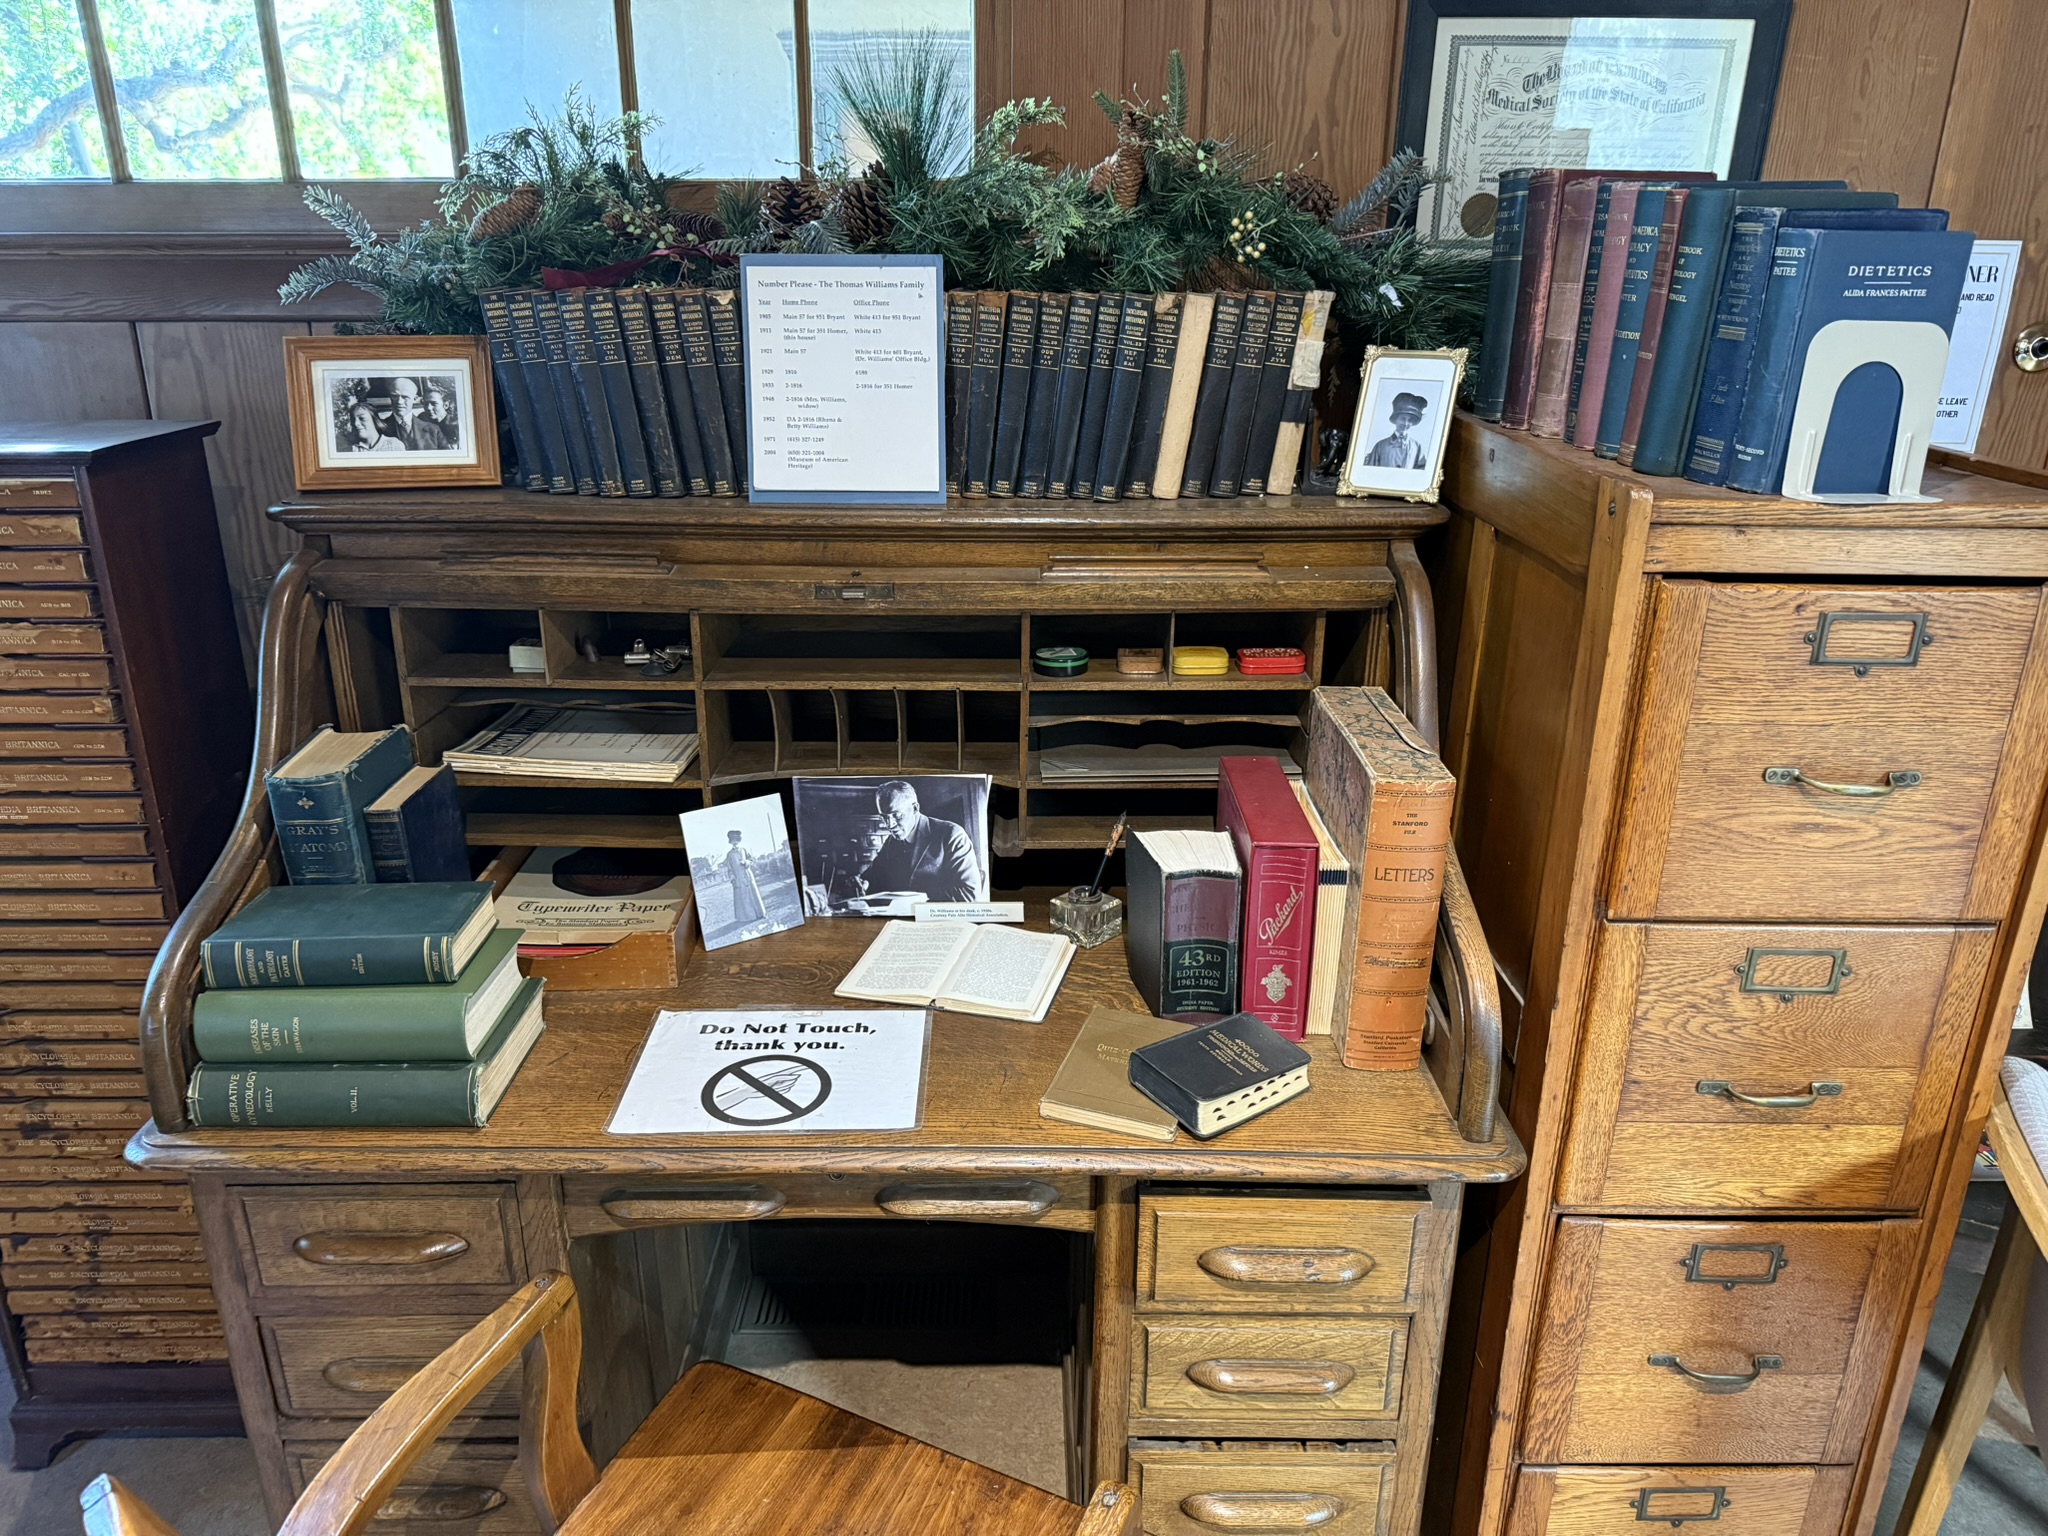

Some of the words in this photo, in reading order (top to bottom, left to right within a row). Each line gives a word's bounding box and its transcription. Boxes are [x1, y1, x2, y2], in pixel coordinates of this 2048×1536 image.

[1522, 72, 1547, 95] The
[1486, 88, 1530, 112] Medical
[1773, 266, 1797, 277] PATTEE
[1848, 266, 1933, 277] DIETETICS
[758, 280, 788, 288] Number
[900, 281, 925, 290] Family
[1843, 289, 1865, 297] ALIDA
[1866, 289, 1899, 297] FRANCES
[1900, 289, 1928, 297] PATTEE
[1961, 293, 1975, 301] AND
[1976, 293, 1995, 302] READ
[1945, 398, 1969, 406] LEAVE
[5, 741, 61, 749] BRITANNICA
[14, 774, 69, 782] BRITANNICA
[27, 806, 81, 814] BRITANNICA
[286, 825, 340, 836] GRAY'S
[1375, 867, 1435, 883] LETTERS
[517, 901, 614, 915] Typewriter
[616, 902, 672, 914] Paper
[1259, 884, 1303, 946] Packard
[432, 951, 441, 973] MOSBY
[1178, 950, 1221, 967] 43RD
[265, 949, 279, 983] PATHOLOGY
[281, 954, 291, 978] CARTER
[1176, 969, 1221, 979] EDITION
[1177, 978, 1219, 987] 1961-1962
[261, 1022, 270, 1039] THE
[700, 1024, 735, 1035] Do
[743, 1023, 789, 1034] Not
[796, 1022, 877, 1035] Touch,
[251, 1018, 263, 1055] DISEASES
[272, 1027, 282, 1047] SKIN
[262, 1041, 272, 1052] OF
[714, 1039, 786, 1051] thank
[794, 1041, 846, 1053] you.
[1210, 1029, 1242, 1056] MEDICAL
[1241, 1051, 1270, 1073] WORDS
[229, 1073, 241, 1123] OPERATIVE
[245, 1069, 258, 1126] GYNECOLOGY
[265, 1087, 274, 1113] KELLY
